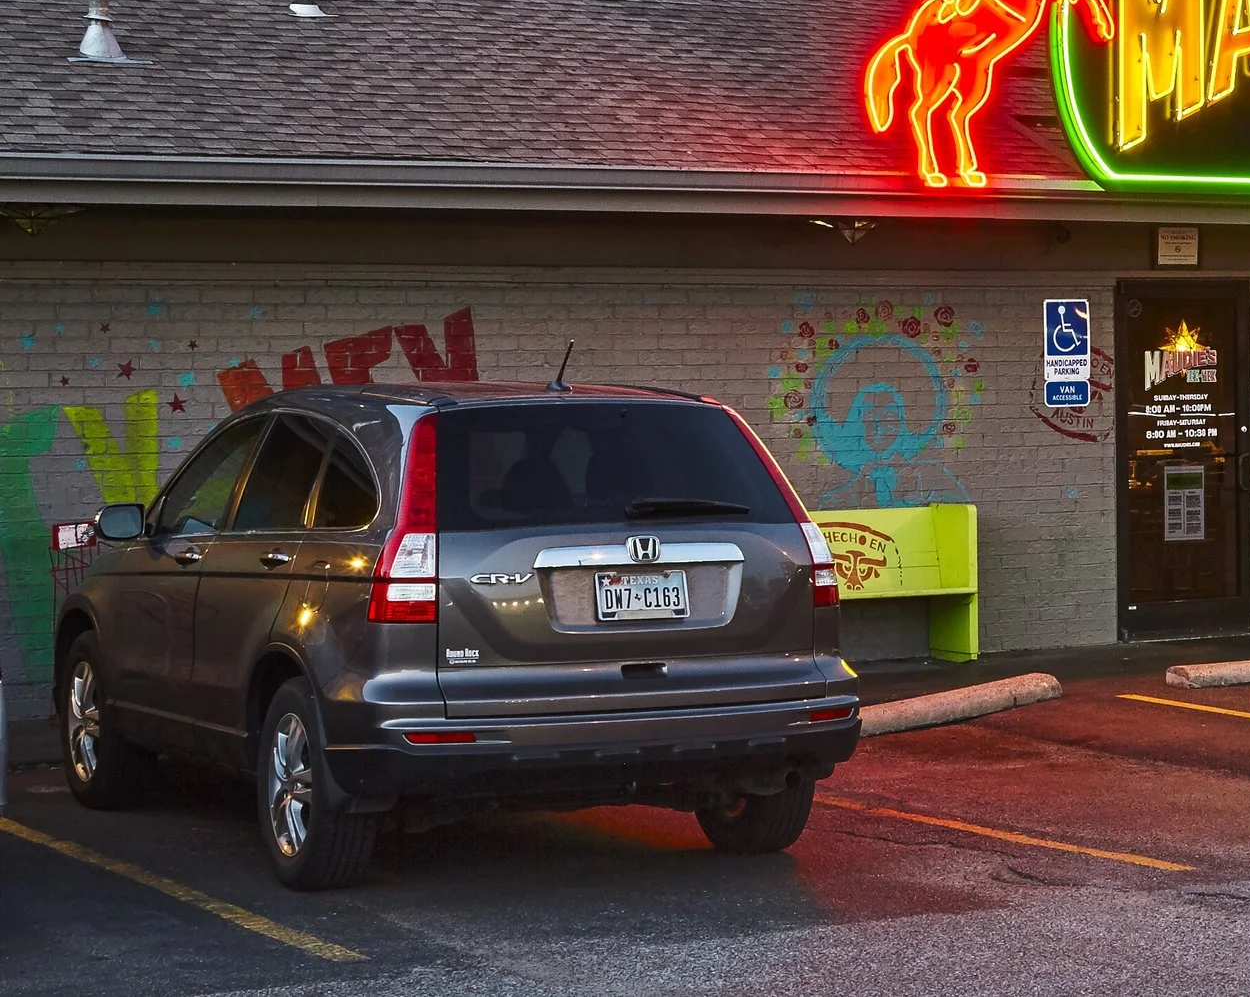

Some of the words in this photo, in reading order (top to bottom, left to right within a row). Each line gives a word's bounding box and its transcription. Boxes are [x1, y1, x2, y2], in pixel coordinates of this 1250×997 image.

[1046, 358, 1088, 368] HANDICAPPED
[1054, 367, 1080, 376] PARKING
[1145, 346, 1217, 391] MAUDIE'S
[1059, 386, 1076, 394] VAN
[1163, 404, 1175, 413] AM
[1050, 407, 1094, 429] AUSTIN
[1146, 430, 1165, 439] 8:00
[1166, 429, 1177, 438] AM
[1184, 429, 1206, 437] 10:30
[1207, 428, 1218, 436] PM
[823, 531, 867, 545] HECHO
[869, 539, 887, 553] EN
[470, 572, 534, 585] CR-V
[621, 575, 659, 585] TEXAS
